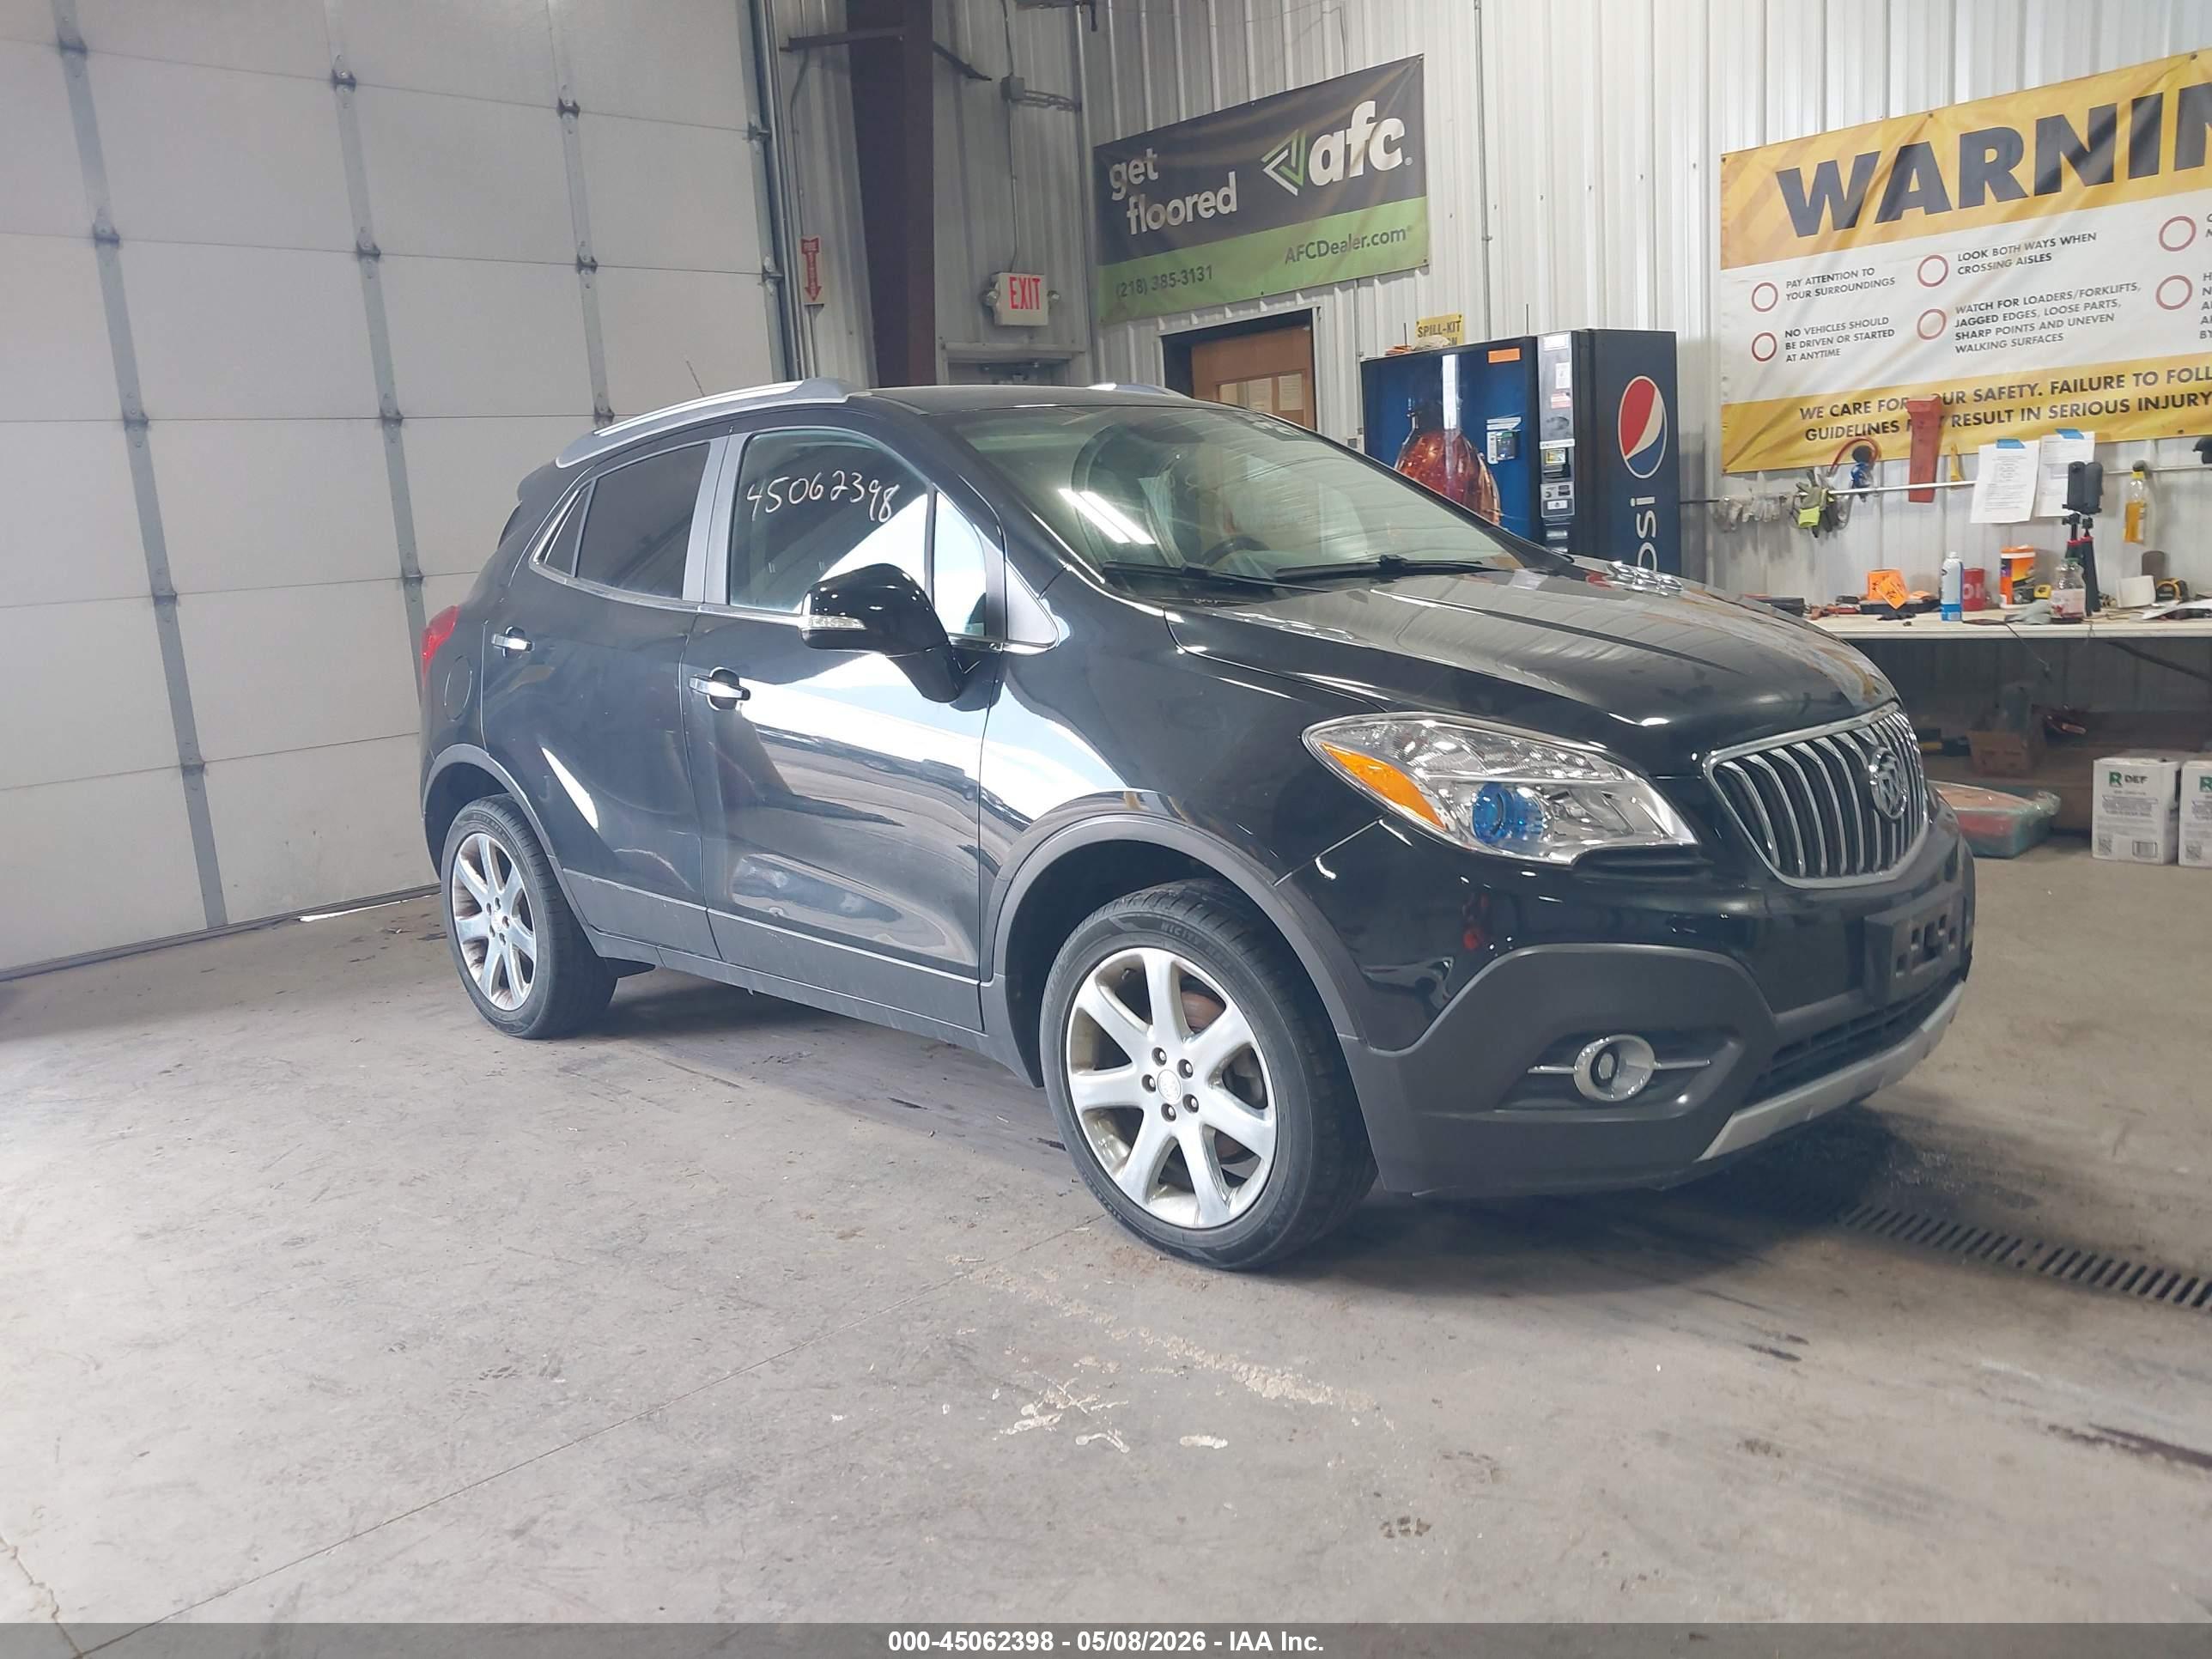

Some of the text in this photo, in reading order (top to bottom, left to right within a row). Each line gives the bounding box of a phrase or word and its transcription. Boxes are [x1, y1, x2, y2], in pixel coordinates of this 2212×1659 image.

[1109, 149, 1158, 200] get
[1127, 171, 1237, 234] floored
[1285, 226, 1407, 264] AFCDealer.com
[1957, 232, 2097, 262] LOOK BOTH WAYS WHEN
[1786, 267, 1875, 289] PAY ATTENTION TO
[1957, 252, 2052, 276] CROSSING AISLES
[1009, 276, 1042, 310] EXIT
[1116, 264, 1212, 298] (218) 385-3131
[1786, 277, 1895, 301] YOUR SURROUNDINGS
[1954, 298, 2121, 328] JAGGED EDGES, LOOSE PARTS,
[1955, 282, 2141, 314] WATCH FOR LOADERS/FORKLIFTS,
[1418, 320, 1462, 338] SPILL-KIT
[1785, 317, 1889, 338] NO VEHICLES SHOULD
[1786, 329, 1895, 350] BE DRIVEN OR STARTED
[1954, 313, 2115, 341] SHARP POINTS AND UNEVEN
[1786, 348, 1841, 362] AT ANYTIME
[1955, 333, 2064, 354] WALKING SURFACES
[1800, 406, 1824, 420] WE
[1830, 400, 1871, 417] CARE
[1972, 383, 2043, 404] SAFETY.
[2051, 374, 2125, 395] FAILURE
[2133, 371, 2159, 386] TO
[1805, 420, 1900, 441] GUIDELINES
[1951, 409, 2014, 428] RESULT
[2021, 407, 2041, 422] IN
[2048, 398, 2130, 419] SERIOUS
[746, 470, 900, 523] 45062398
